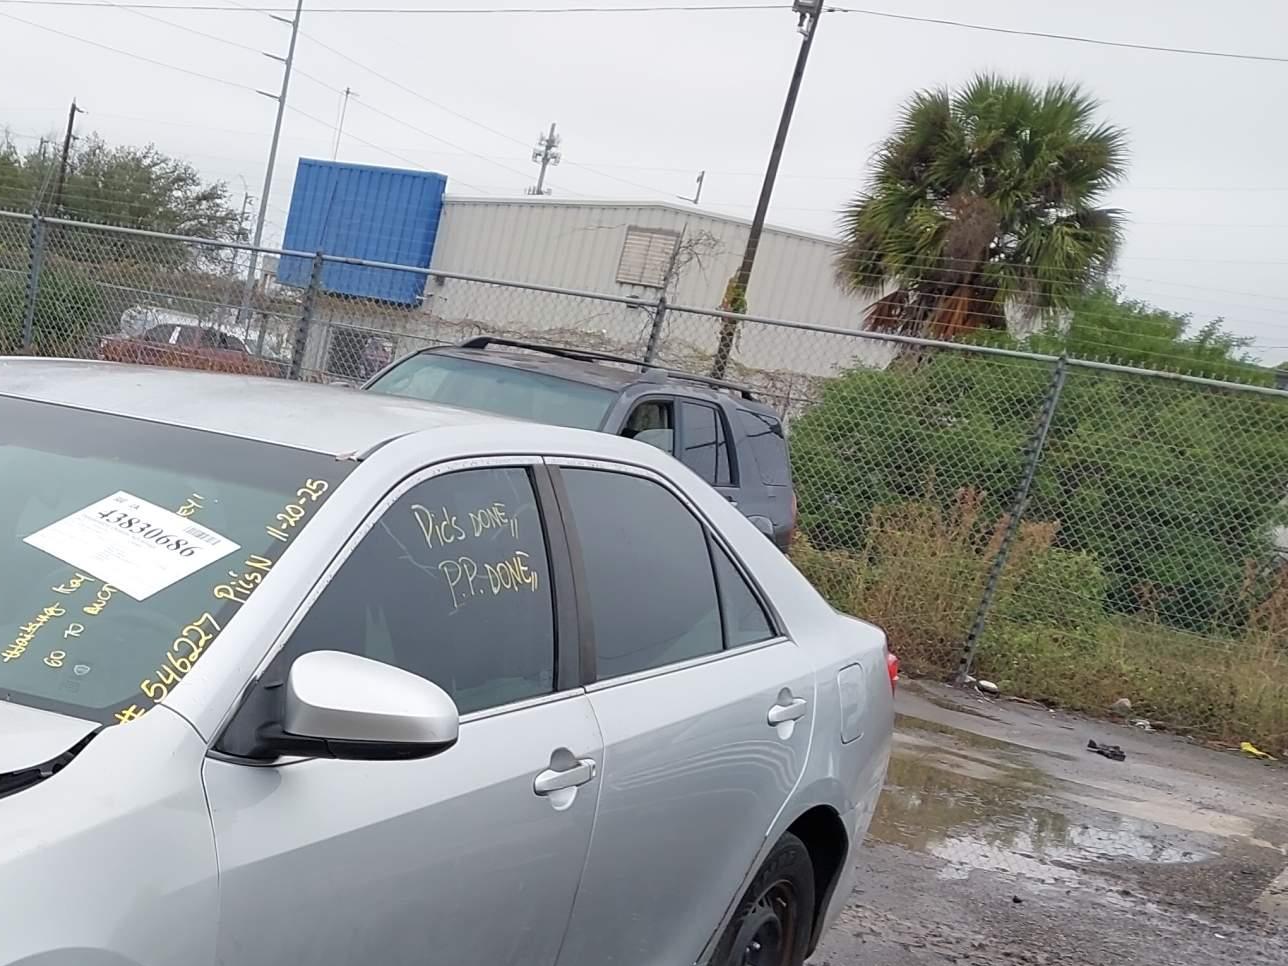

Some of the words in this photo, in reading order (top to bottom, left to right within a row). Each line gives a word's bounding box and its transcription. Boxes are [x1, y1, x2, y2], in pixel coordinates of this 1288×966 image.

[97, 508, 201, 557] 43830686
[140, 612, 221, 703] 546227
[265, 478, 329, 542] 11-20-25
